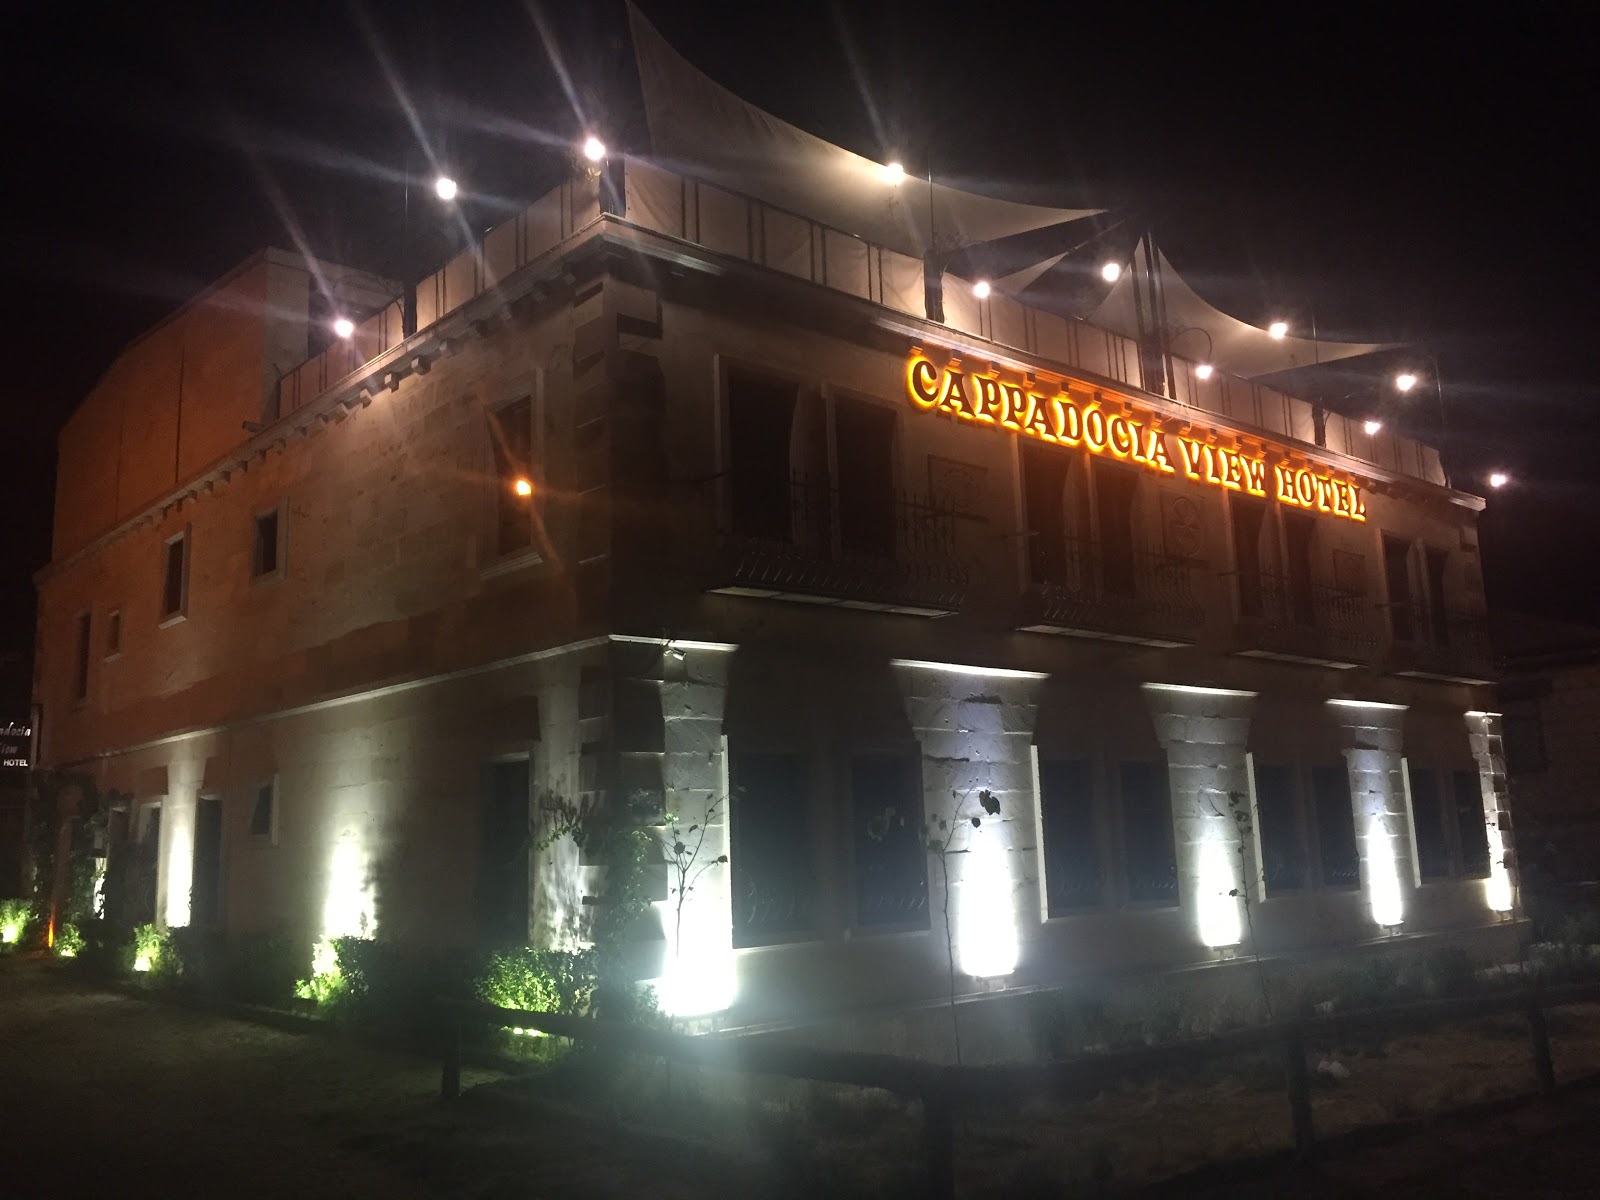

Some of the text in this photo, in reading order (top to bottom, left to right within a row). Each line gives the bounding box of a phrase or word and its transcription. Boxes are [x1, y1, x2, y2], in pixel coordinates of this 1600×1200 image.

[908, 356, 1367, 522] CAPPADOCIA VIEW HOTEL
[3, 758, 29, 767] HOTEL
